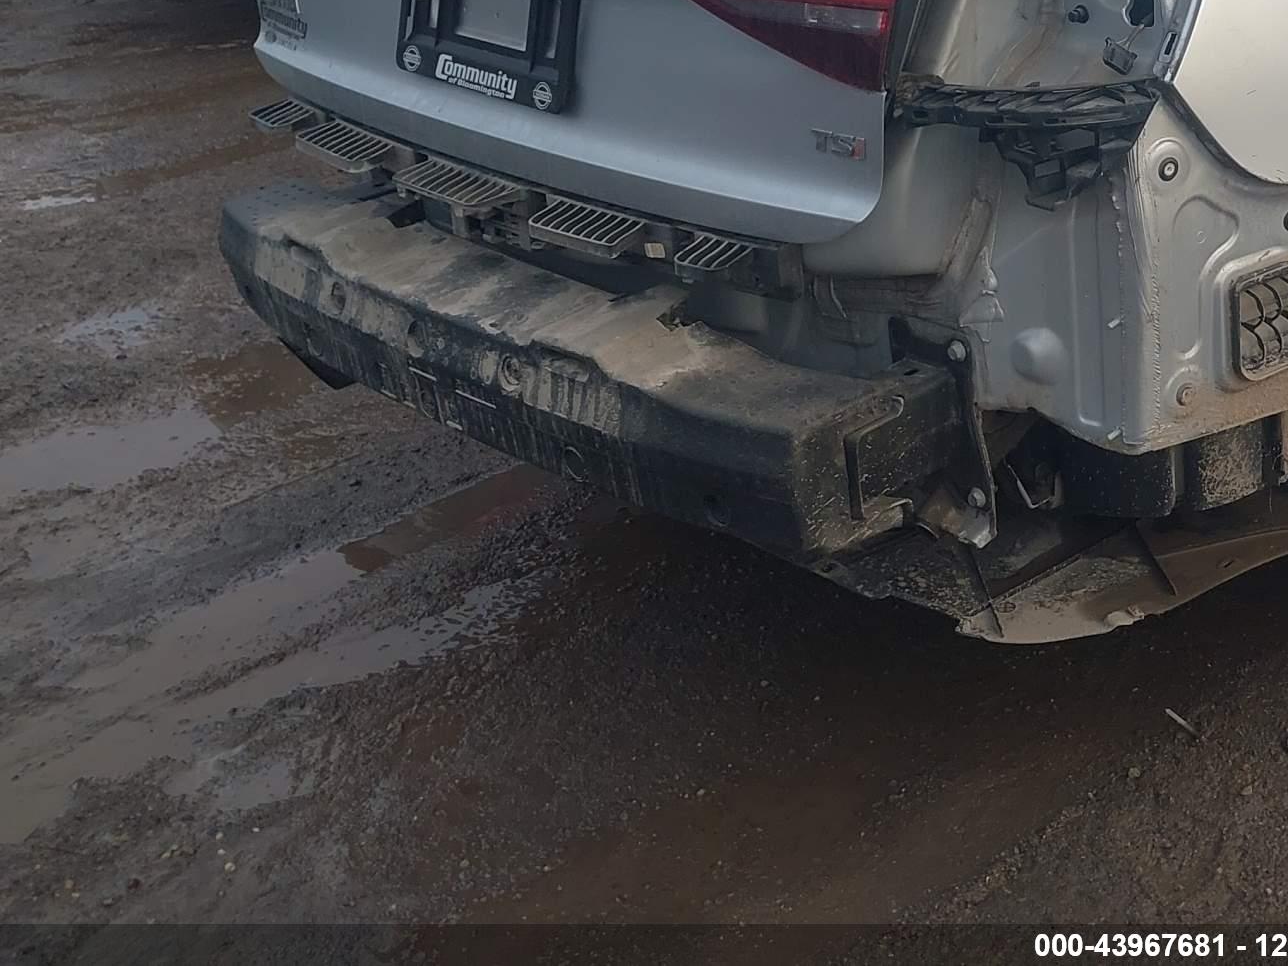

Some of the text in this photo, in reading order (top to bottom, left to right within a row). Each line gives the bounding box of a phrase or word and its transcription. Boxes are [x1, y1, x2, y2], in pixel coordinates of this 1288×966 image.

[435, 53, 518, 100] Community
[447, 76, 505, 99] of Bloomington
[811, 128, 865, 161] TSI
